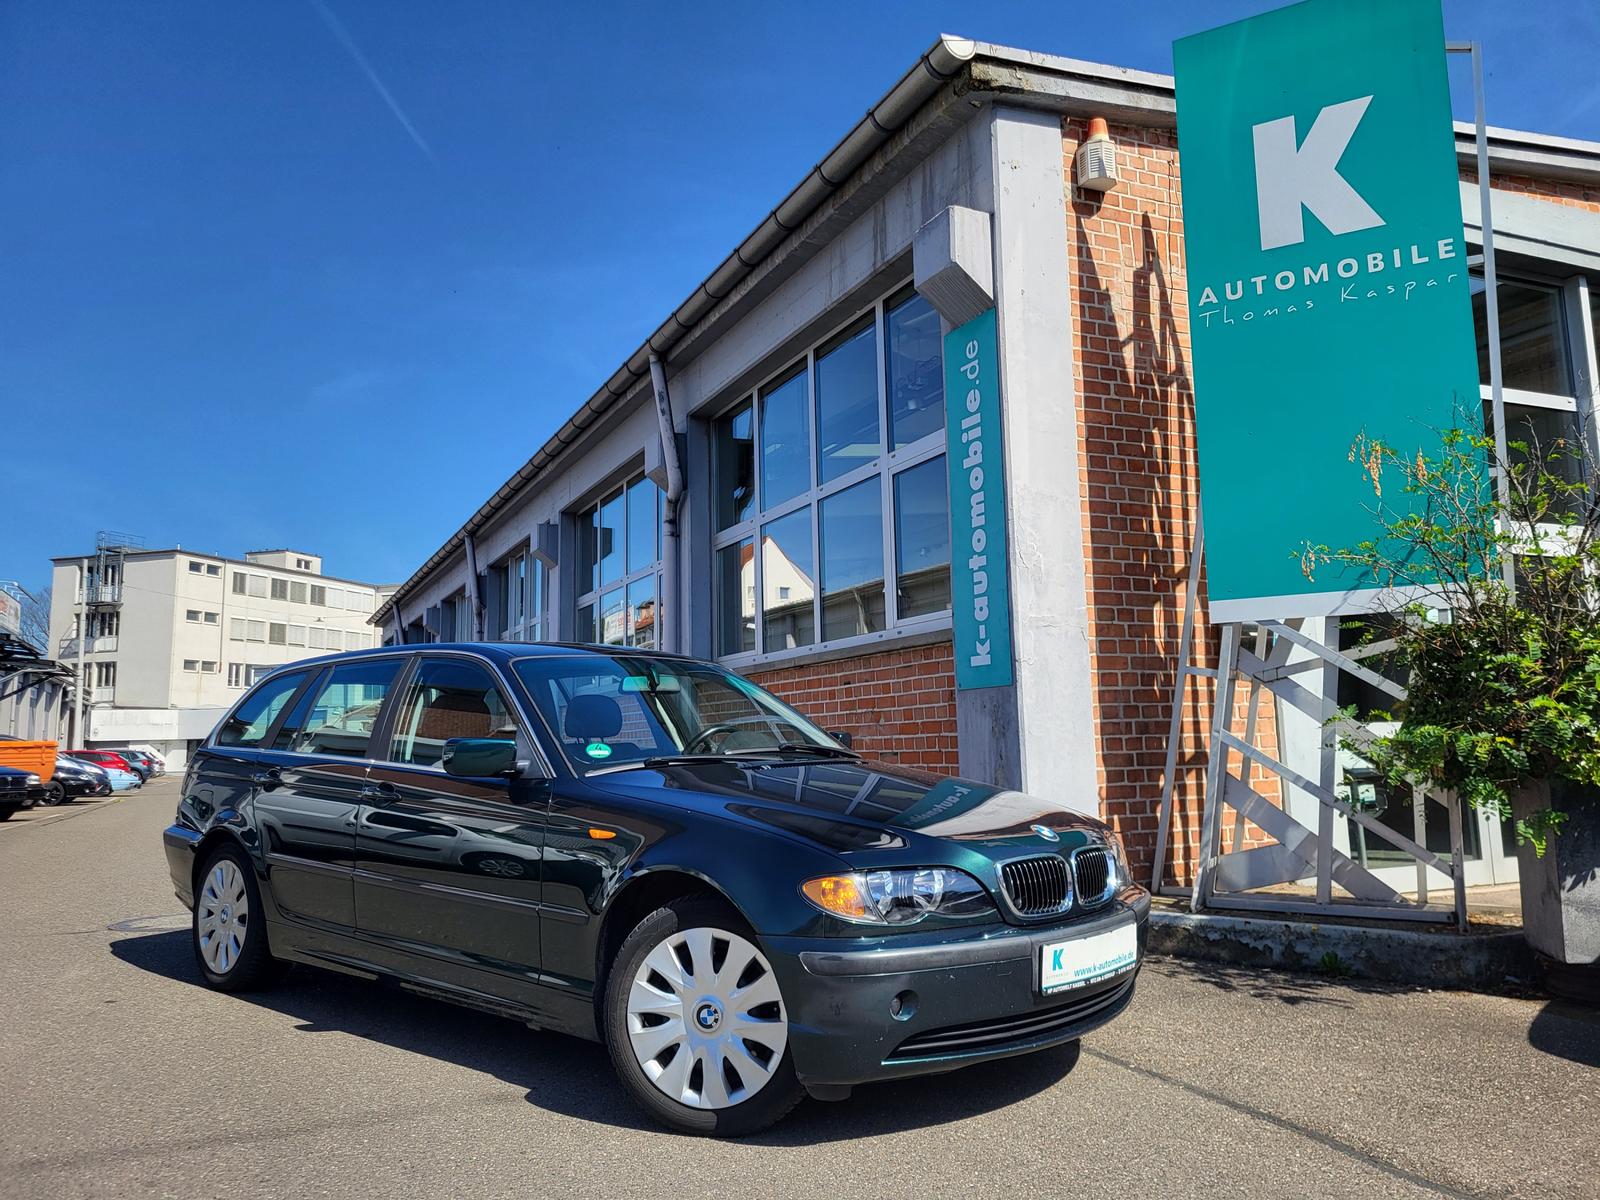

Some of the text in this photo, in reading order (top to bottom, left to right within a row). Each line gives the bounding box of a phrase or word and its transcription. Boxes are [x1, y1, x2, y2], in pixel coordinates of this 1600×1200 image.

[1252, 95, 1387, 250] K
[1198, 238, 1456, 306] AUTOMOBILE
[1199, 274, 1458, 328] Thomas Kaspar
[960, 339, 992, 667] k-automobile.de
[1052, 948, 1064, 971] K
[1073, 951, 1134, 977] www.k-automobile.de
